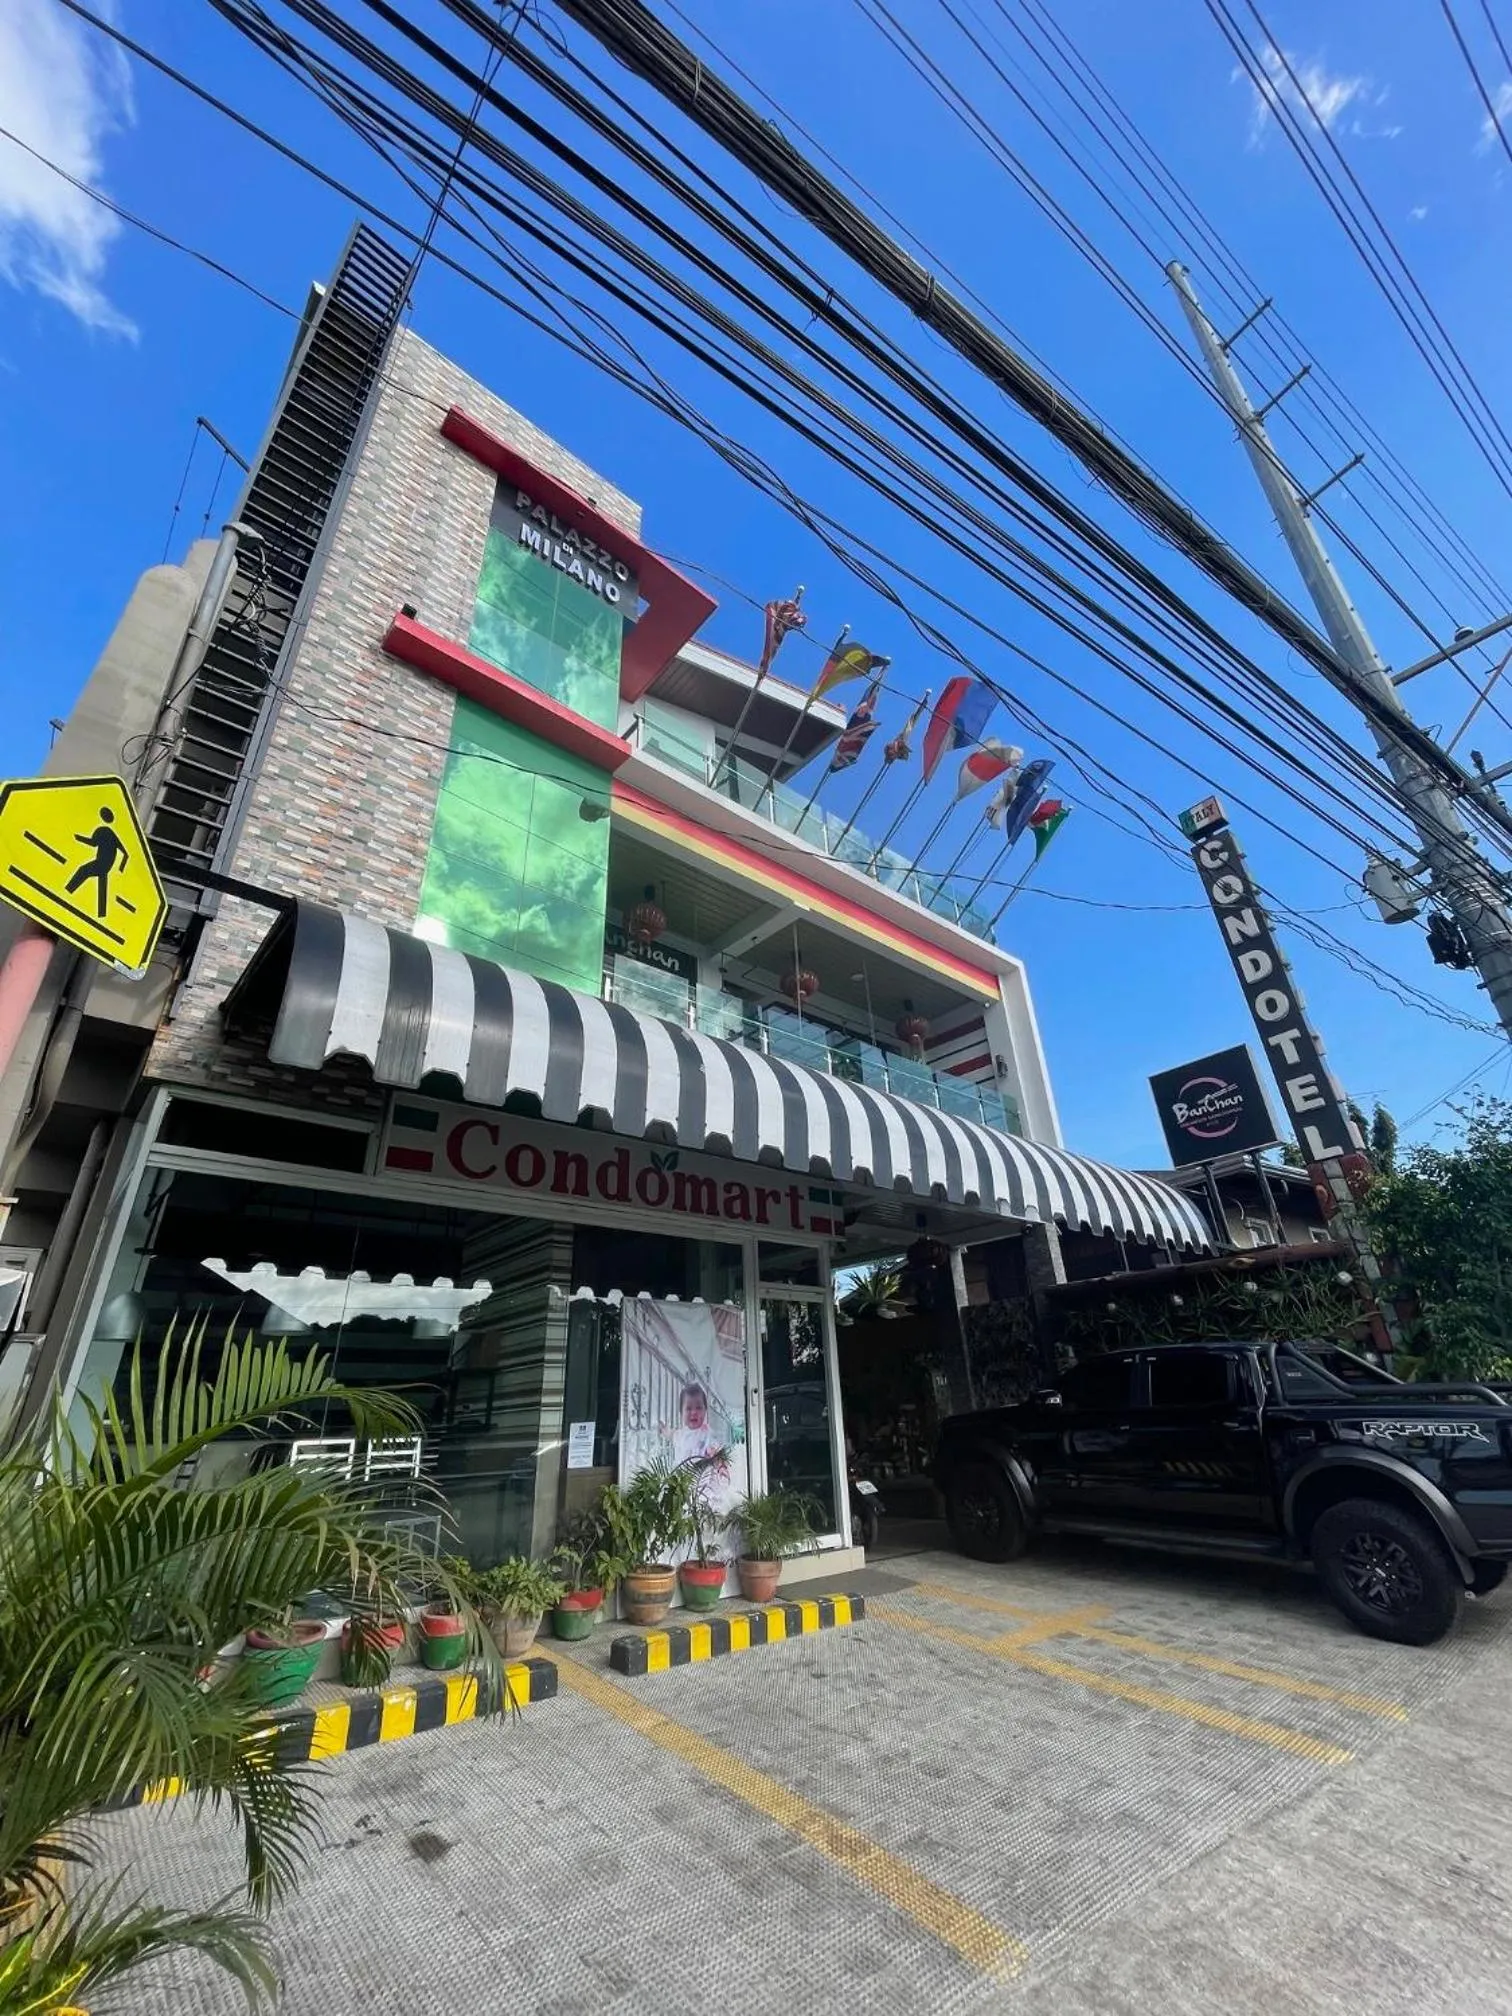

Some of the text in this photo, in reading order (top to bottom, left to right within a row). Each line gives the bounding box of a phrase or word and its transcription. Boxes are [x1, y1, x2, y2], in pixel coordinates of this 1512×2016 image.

[516, 491, 629, 581] PALAZZO
[520, 522, 621, 603] MILANO
[562, 542, 574, 556] DI
[1200, 840, 1344, 1161] CONDOTEL
[1172, 1093, 1243, 1125] BanChan
[446, 1119, 805, 1231] Condomart
[1362, 1421, 1490, 1443] RAPTOR
